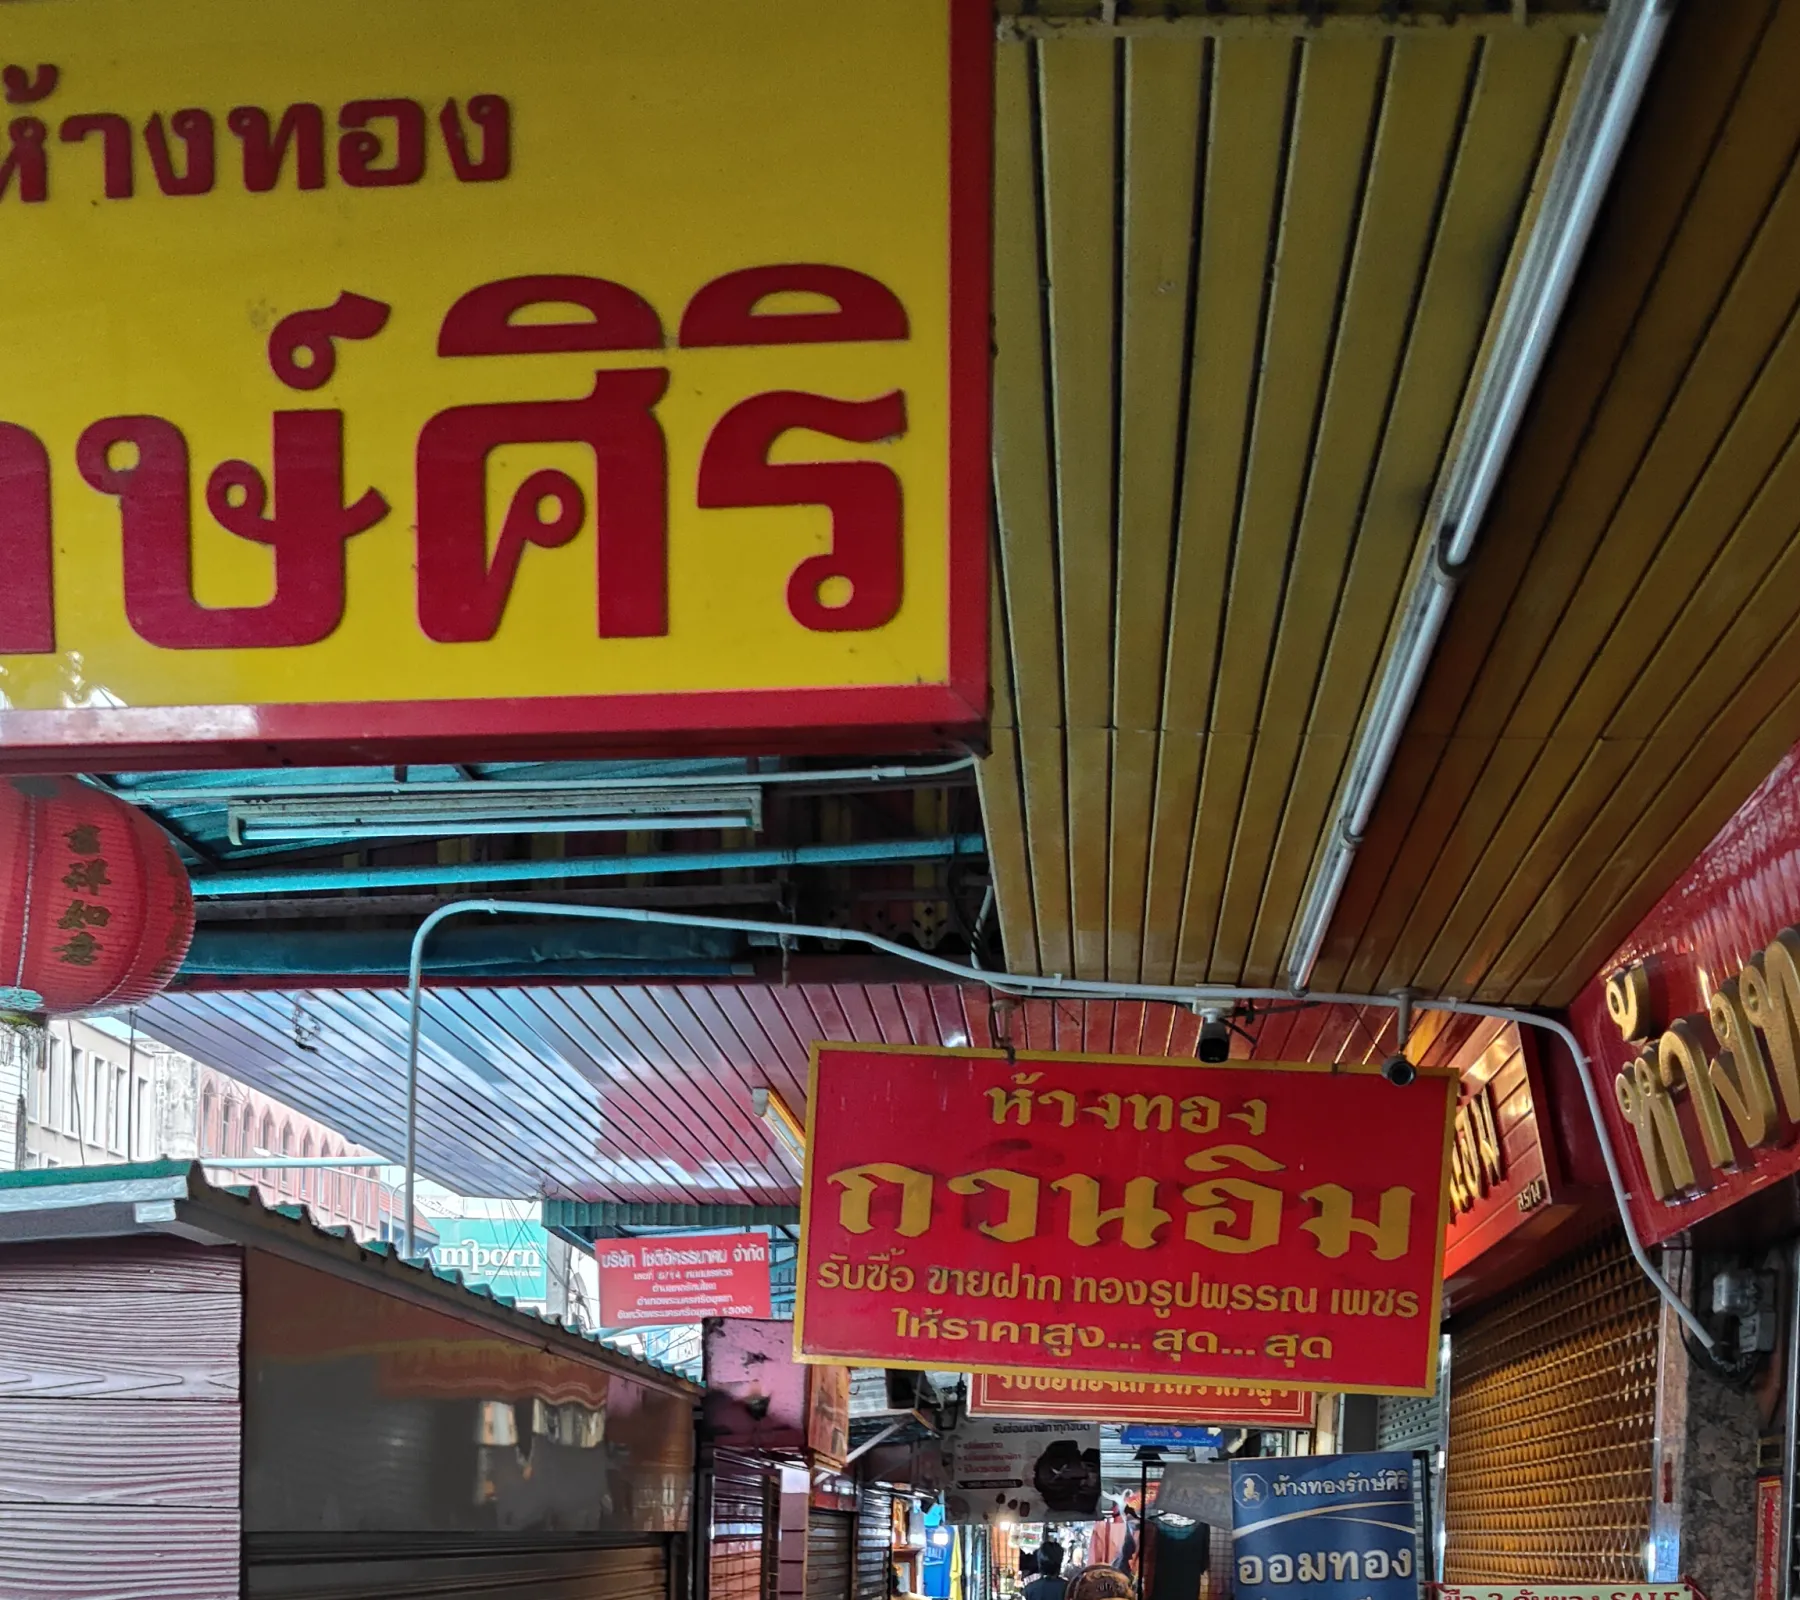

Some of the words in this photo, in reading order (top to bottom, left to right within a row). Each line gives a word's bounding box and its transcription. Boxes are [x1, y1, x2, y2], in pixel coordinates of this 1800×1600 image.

[984, 1072, 1269, 1136] ห้างทอง
[826, 1144, 1416, 1261] กวนอิม
[732, 1243, 765, 1263] จำกัด
[816, 1248, 915, 1293] รับซื้อ
[926, 1262, 1062, 1301] ขายฝาก
[1073, 1271, 1317, 1318] ทองรูปพรรณ
[1330, 1288, 1419, 1318] เพชร
[1264, 1333, 1333, 1368] สุด
[1271, 1469, 1409, 1497] ห้างทองรักษ์ศิริ
[1239, 1548, 1412, 1585] ออมทอง
